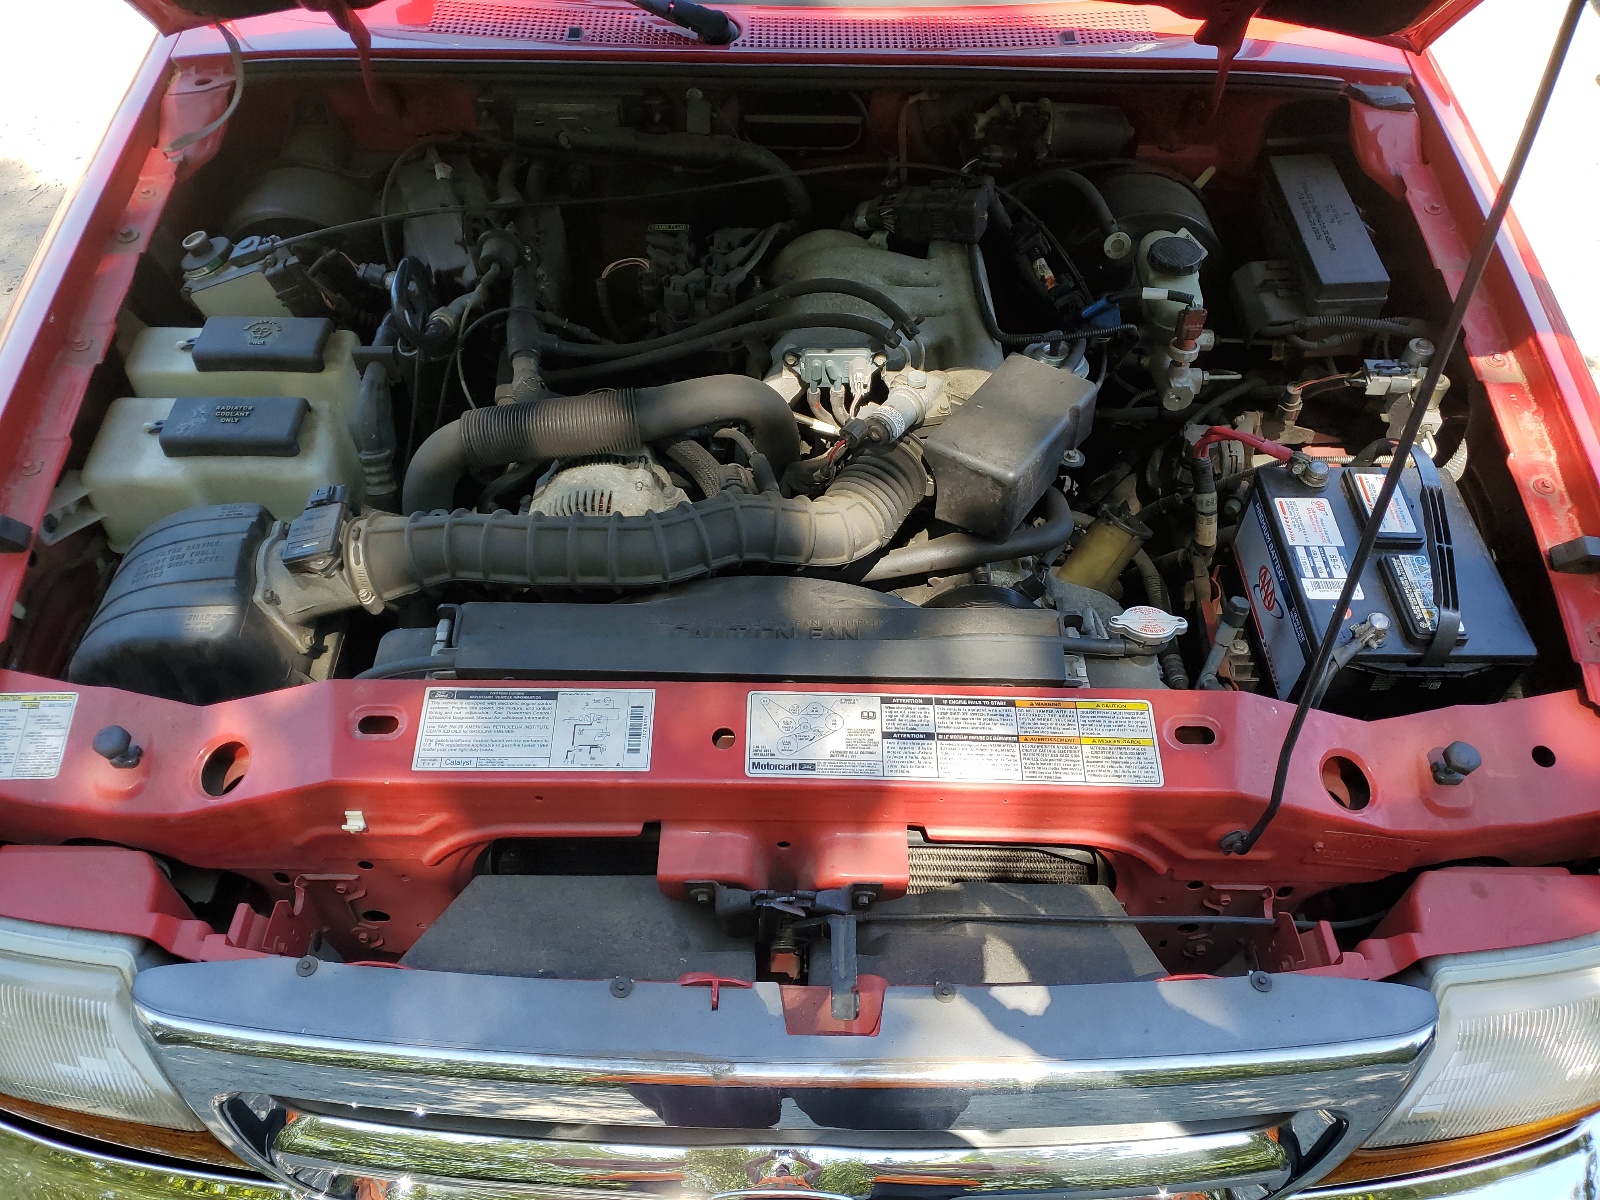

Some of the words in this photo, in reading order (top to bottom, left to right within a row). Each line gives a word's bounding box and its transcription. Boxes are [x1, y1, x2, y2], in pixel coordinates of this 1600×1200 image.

[1255, 502, 1272, 542] PREMIUM
[1268, 542, 1285, 582] BATTERY
[189, 548, 217, 558] TOOLS
[1259, 566, 1275, 611] AAA
[808, 626, 859, 640] FAN
[752, 762, 797, 771] Motorcraft
